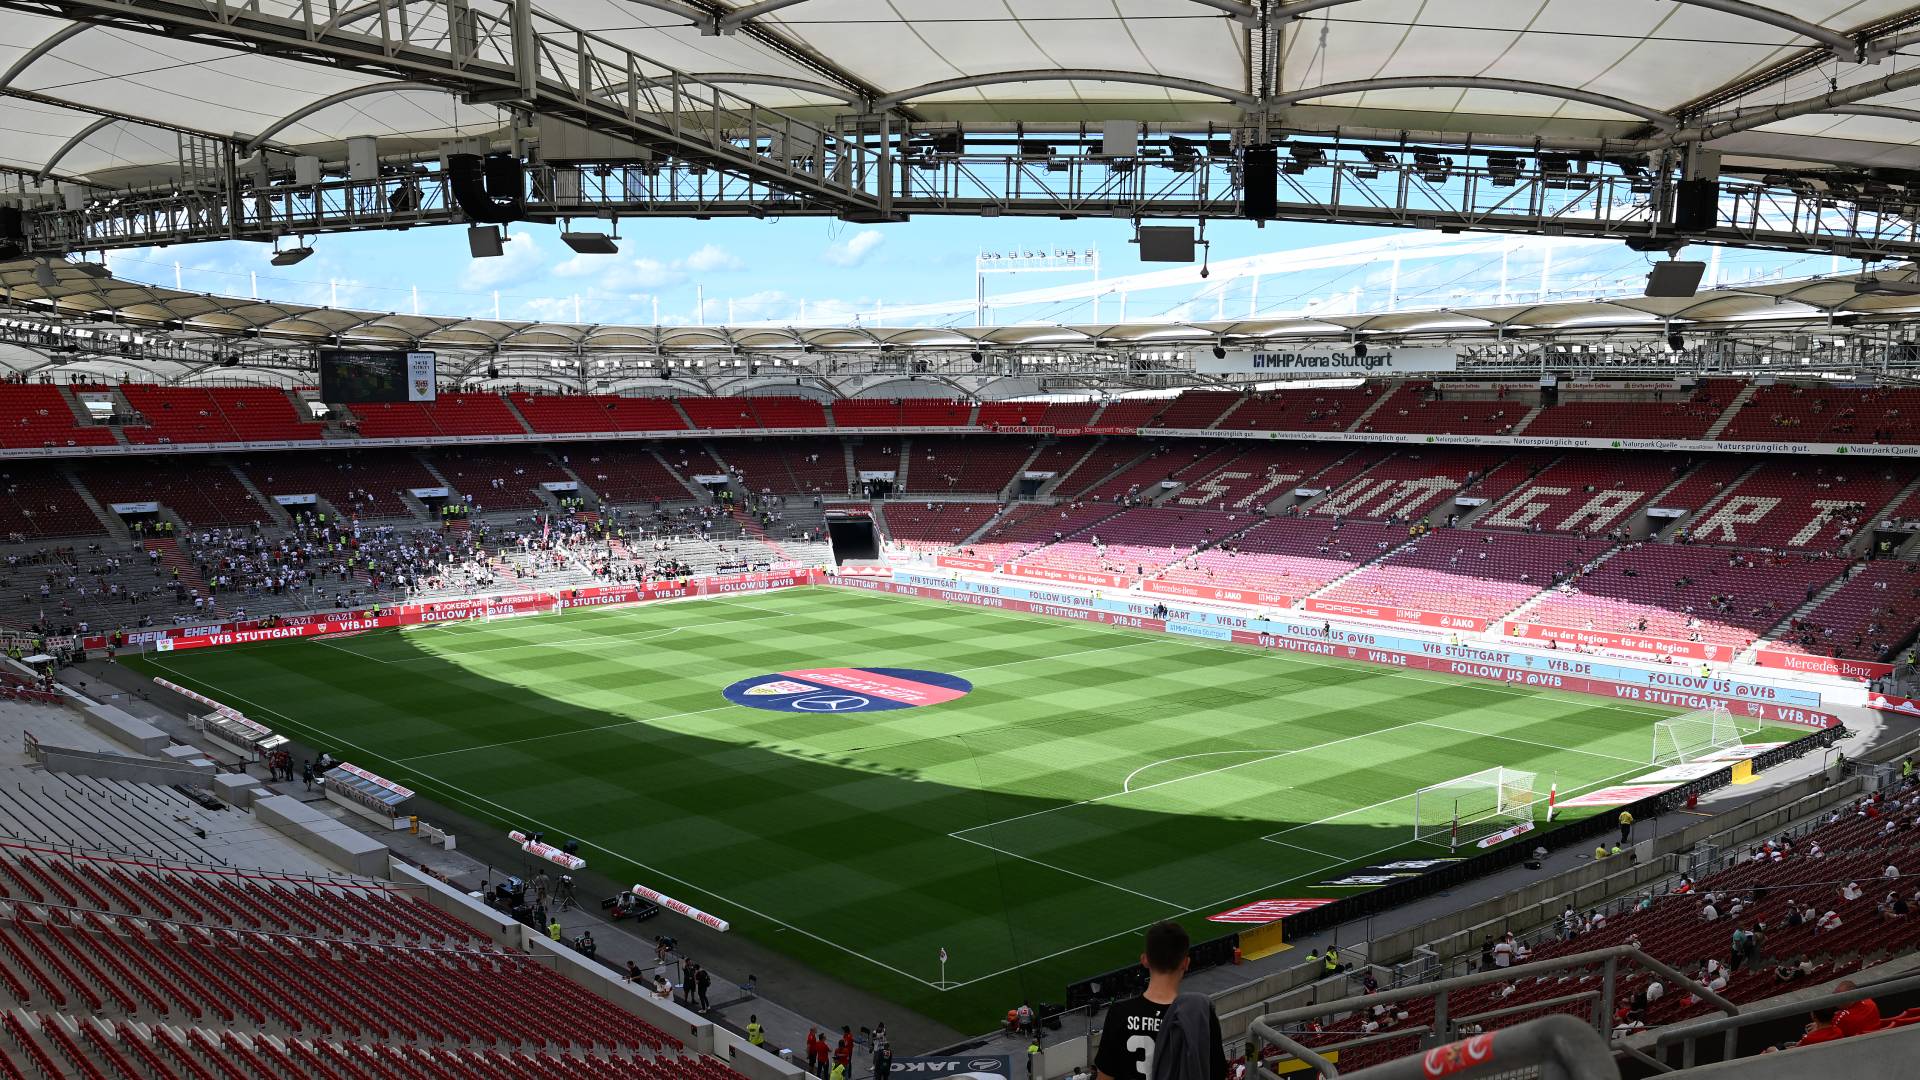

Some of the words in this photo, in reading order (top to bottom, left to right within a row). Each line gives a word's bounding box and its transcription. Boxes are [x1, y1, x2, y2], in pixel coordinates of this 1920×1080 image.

[1331, 353, 1393, 370] Stuttgart
[1513, 437, 1573, 447] Natursprünglich
[1575, 439, 1590, 447] gut.
[1622, 440, 1655, 450] Naturpark
[1655, 441, 1678, 449] Quelle
[1717, 442, 1788, 452] Natursprünglich
[1791, 444, 1810, 453] gut.
[1850, 445, 1890, 455] Naturpark
[1891, 446, 1919, 455] Quelle
[719, 582, 757, 593] FOLLOW
[772, 578, 794, 588] @VfB
[828, 576, 843, 585] VfB
[844, 577, 878, 590] STUTTGART
[896, 585, 918, 596] VfB.DE
[910, 576, 921, 584] VfB
[921, 577, 957, 589] STUTTGART
[977, 585, 1000, 594] VfB.DE
[1152, 582, 1198, 596] Mercedes-Benz
[573, 594, 627, 607] STUTTGART
[655, 588, 686, 599] VfB.DE
[942, 592, 970, 603] FOLLOW
[972, 596, 981, 604] US
[983, 597, 1003, 607] @VfB
[1029, 591, 1059, 602] FOLLOW
[1061, 595, 1071, 604] US
[1074, 597, 1094, 606] @VfB
[1223, 591, 1241, 600] JAKO
[1265, 594, 1281, 603] MHP
[421, 609, 467, 622] FOLLOW
[488, 604, 514, 616] @VfB
[1030, 603, 1043, 614] VfB
[1045, 605, 1089, 619] STUTTGART
[1113, 615, 1142, 628] VfB.DE
[1128, 604, 1142, 614] VfB
[1145, 606, 1190, 621] STGART
[1216, 616, 1247, 628] VfB.DE
[1315, 602, 1379, 616] PORSCHE
[1404, 610, 1422, 620] MHP
[327, 612, 352, 622] GAZI
[1451, 618, 1474, 629] JAKO
[127, 630, 168, 644] EHEIM
[183, 625, 222, 638] EHEIM
[209, 633, 232, 645] VfB
[235, 627, 304, 643] STUTTGART
[339, 618, 379, 631] VfB.DE
[1331, 630, 1344, 641] US
[1347, 634, 1375, 645] @VfB
[1541, 628, 1558, 638] Aus
[1559, 630, 1574, 640] der
[1578, 633, 1608, 644] Region
[1621, 637, 1635, 647] für
[1641, 640, 1654, 650] die
[1656, 642, 1689, 654] Region
[1258, 635, 1275, 647] VfB
[1278, 638, 1335, 655] STUTTGART
[1368, 650, 1407, 665] VfB.DE
[1422, 642, 1441, 654] VfB
[1445, 645, 1510, 664] STUTTGART
[1547, 659, 1591, 675] VfB.DE
[1784, 656, 1871, 677] Mercedes-Benz
[1451, 662, 1503, 678] FOLLOW
[1506, 669, 1522, 682] US
[1526, 673, 1562, 687] @VfB
[1648, 672, 1708, 690] FOLLOW
[1713, 680, 1730, 693] US
[1735, 685, 1775, 699] @VfB
[1616, 685, 1640, 699] VfB
[1645, 689, 1729, 711] STUTTGART
[1777, 708, 1827, 728] VfB.DE
[1127, 1015, 1140, 1031] SC
[1142, 1017, 1163, 1032] FRE
